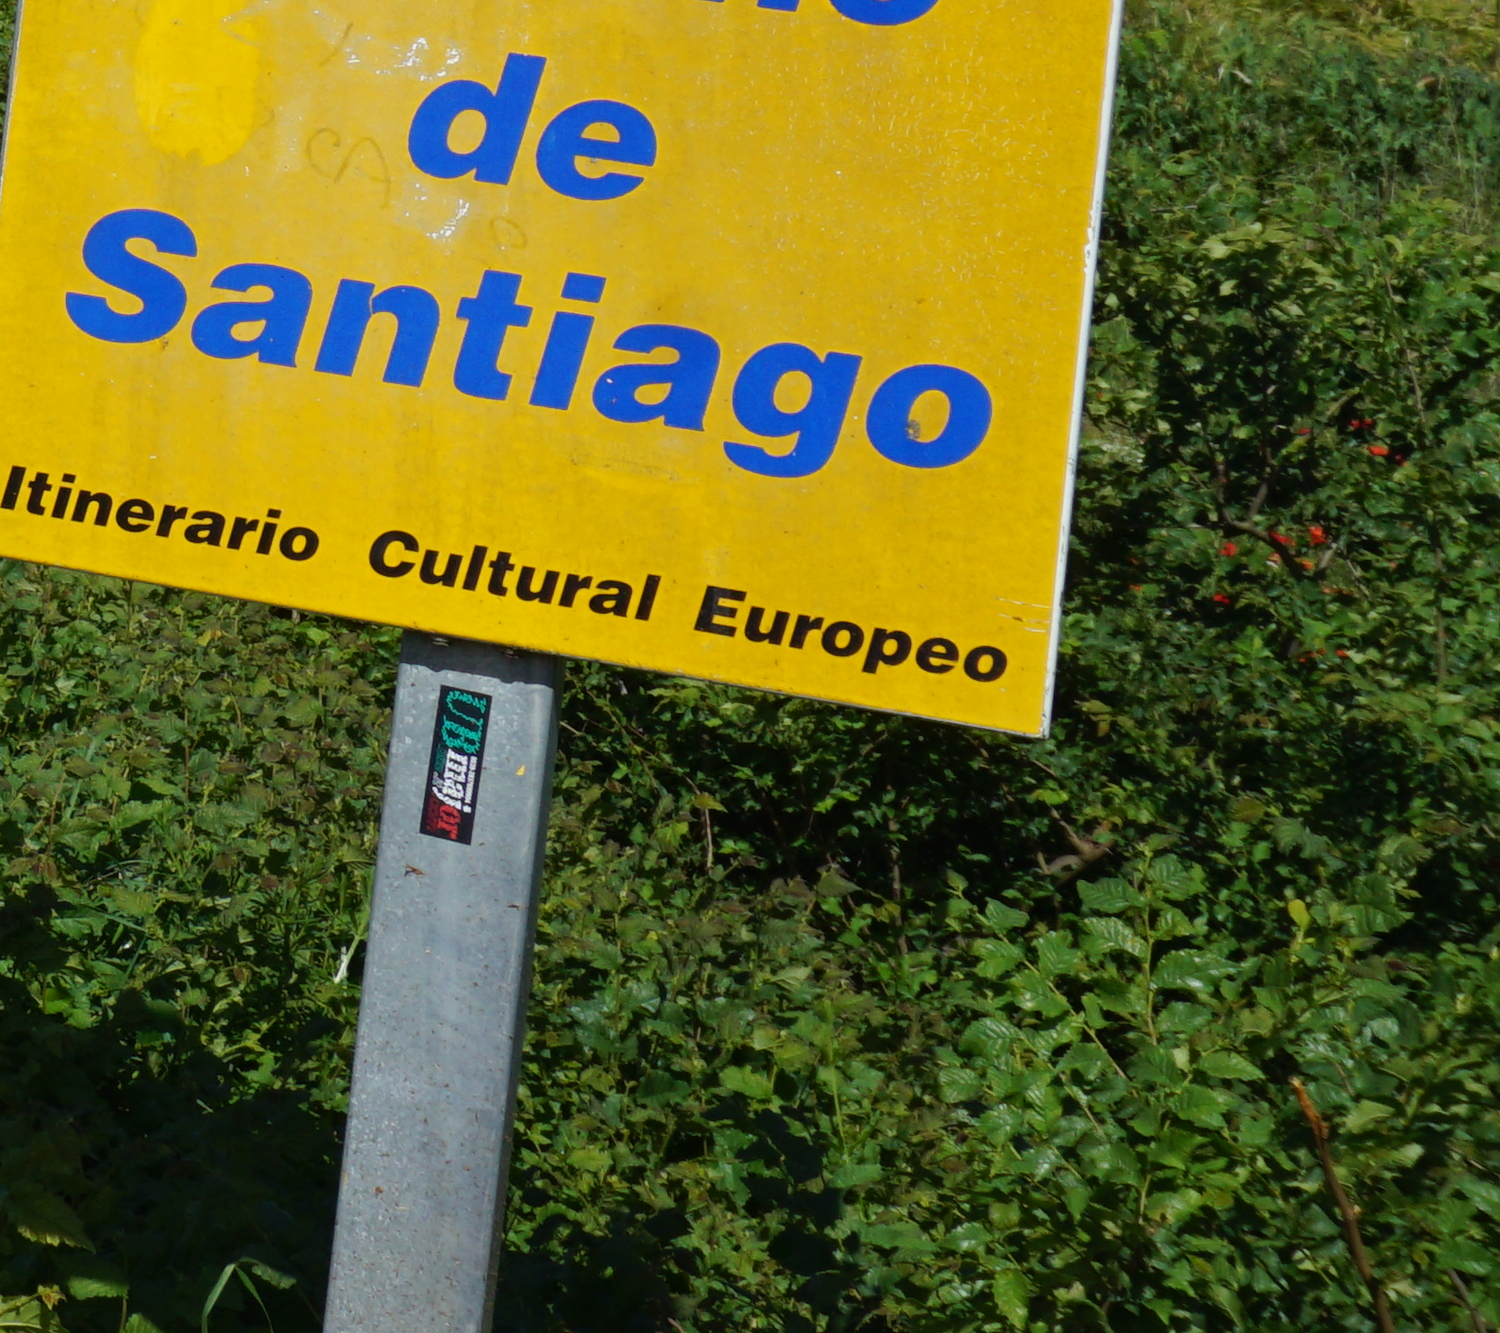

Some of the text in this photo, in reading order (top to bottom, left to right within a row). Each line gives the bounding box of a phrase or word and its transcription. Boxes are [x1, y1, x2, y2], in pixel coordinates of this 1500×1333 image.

[410, 54, 655, 199] de
[67, 210, 990, 476] Santiago
[2, 467, 1006, 681] Itinerario Cultural Europeo
